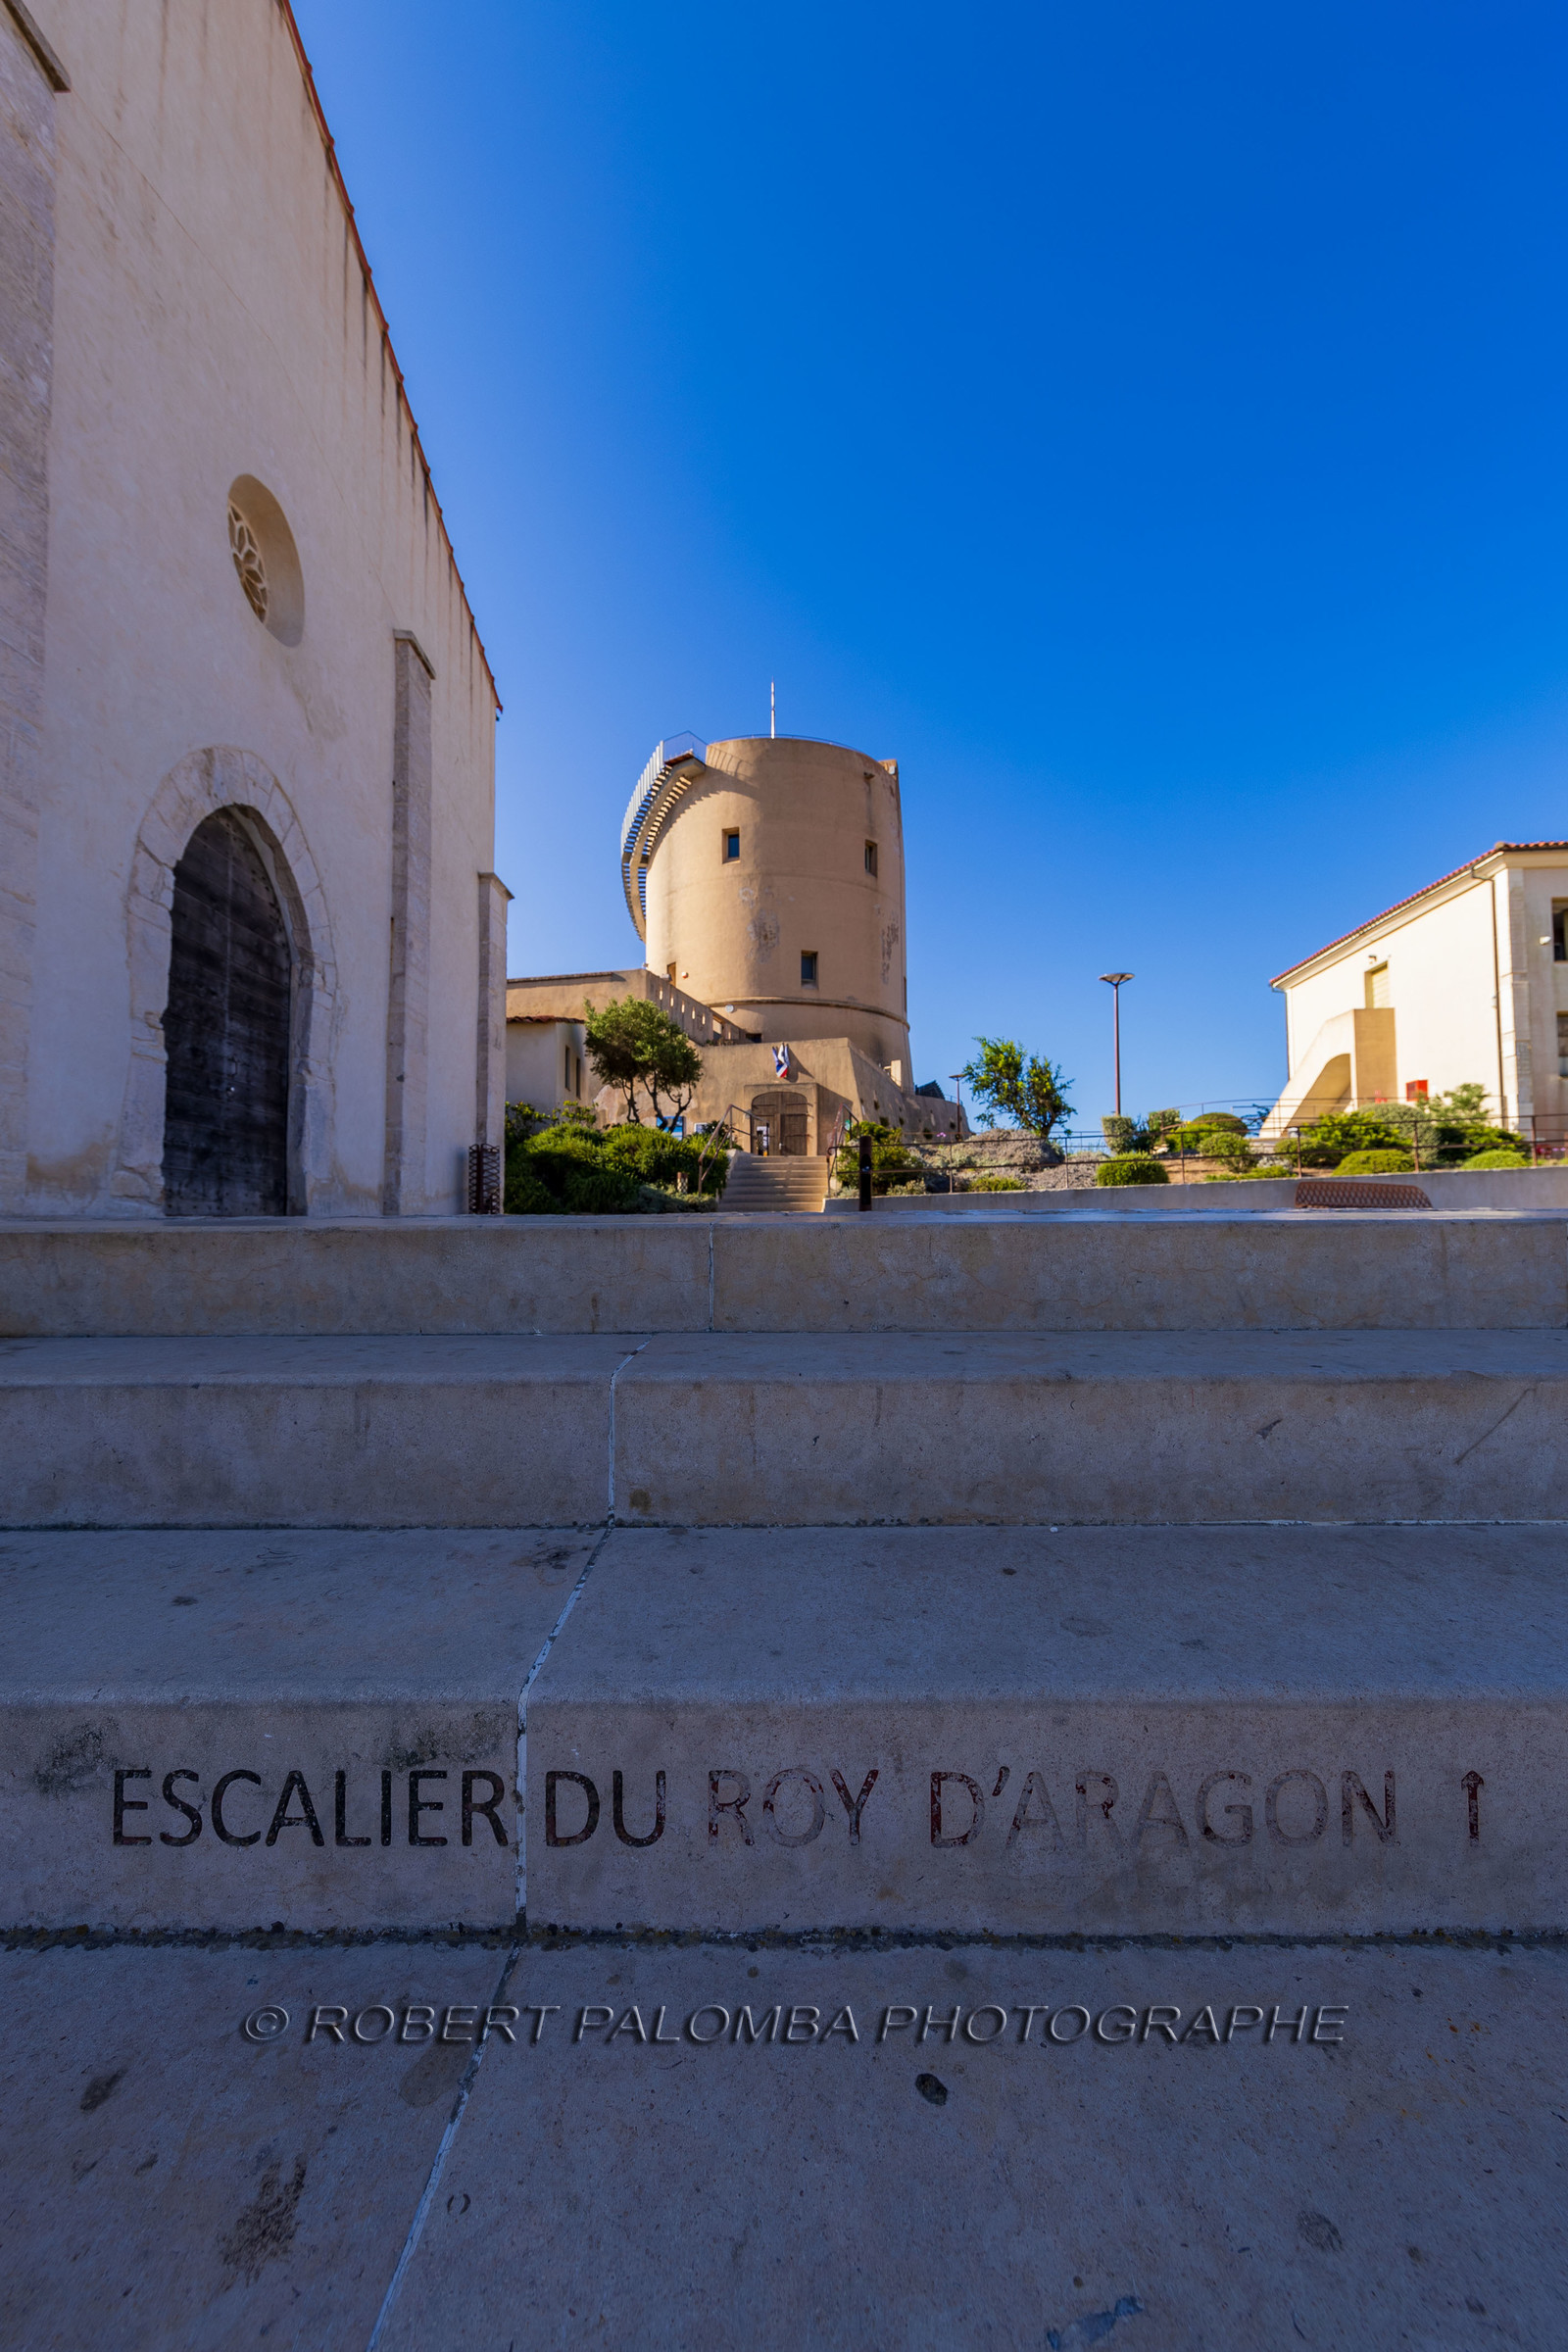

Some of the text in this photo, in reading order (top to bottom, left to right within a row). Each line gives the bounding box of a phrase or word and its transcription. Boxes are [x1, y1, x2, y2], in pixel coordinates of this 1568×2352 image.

[113, 1766, 1397, 1848] ESCALIER DU ROY D'ARAGON
